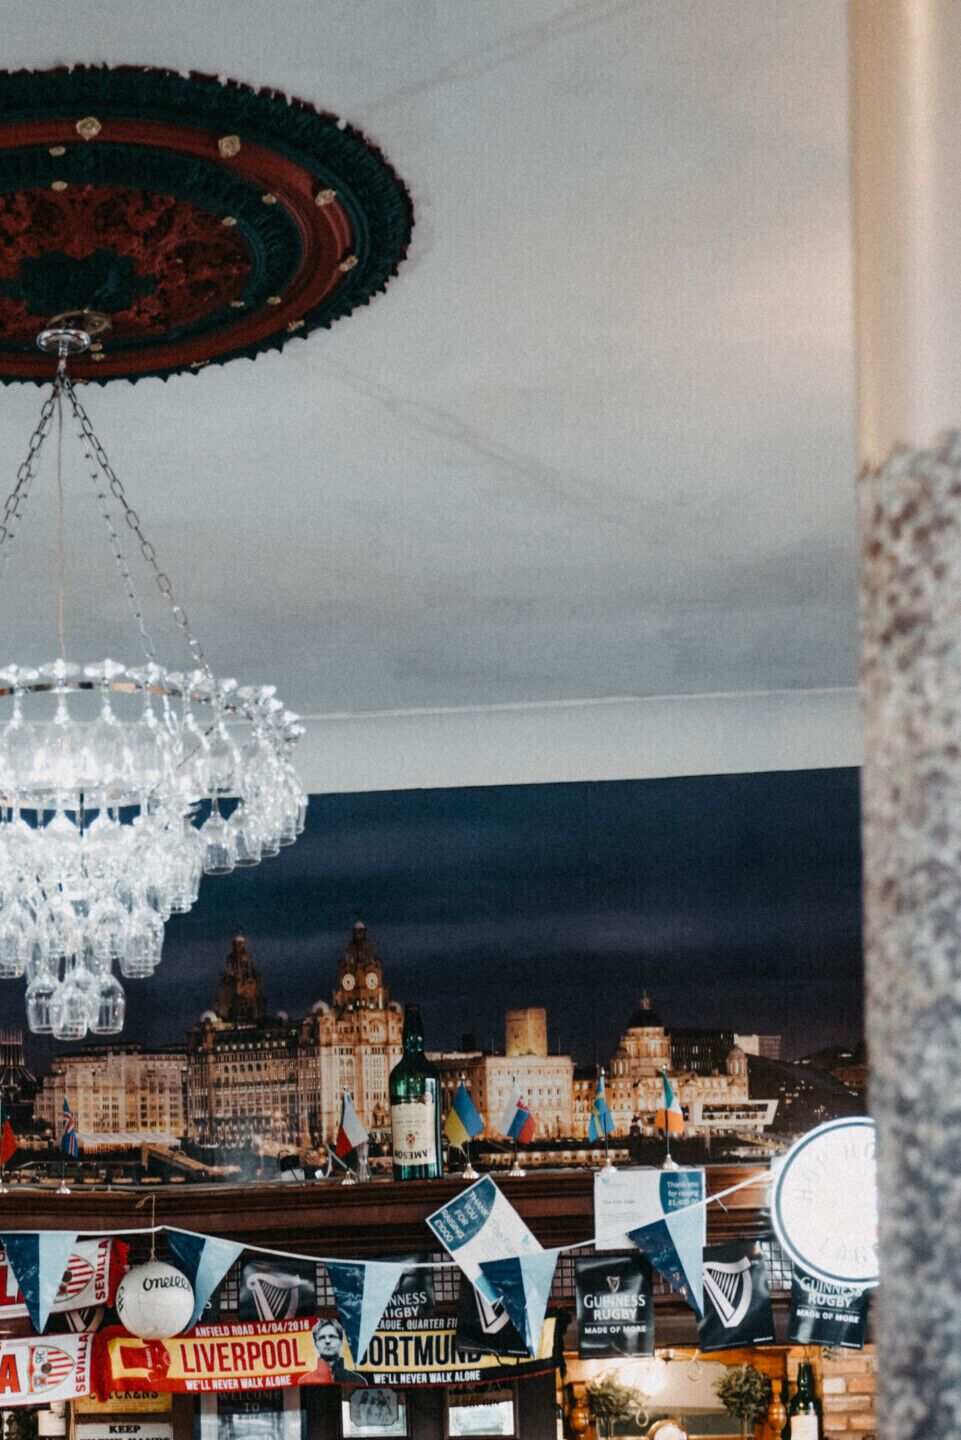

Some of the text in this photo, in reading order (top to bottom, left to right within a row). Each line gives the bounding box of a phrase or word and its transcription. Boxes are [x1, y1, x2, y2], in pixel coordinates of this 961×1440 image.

[95, 1239, 110, 1300] SEVILLA
[583, 1294, 647, 1309] GUINNESS
[807, 1293, 853, 1309] RUGBY
[593, 1308, 638, 1320] RUGBY
[822, 1311, 833, 1320] OF
[195, 1326, 230, 1338] ANFIELD
[232, 1324, 254, 1337] ROAD
[406, 1317, 444, 1331] QUARTER
[584, 1324, 647, 1334] MADE OF MORE
[179, 1338, 307, 1374] LIVERPOOL
[75, 1334, 89, 1393] SEVILLA
[185, 1374, 292, 1391] WE'LL NEVER WALK ALONE
[373, 1370, 481, 1385] WE'LL NEVER WALK ALONE
[244, 1402, 260, 1413] TO
[108, 1425, 141, 1434] KEEP
